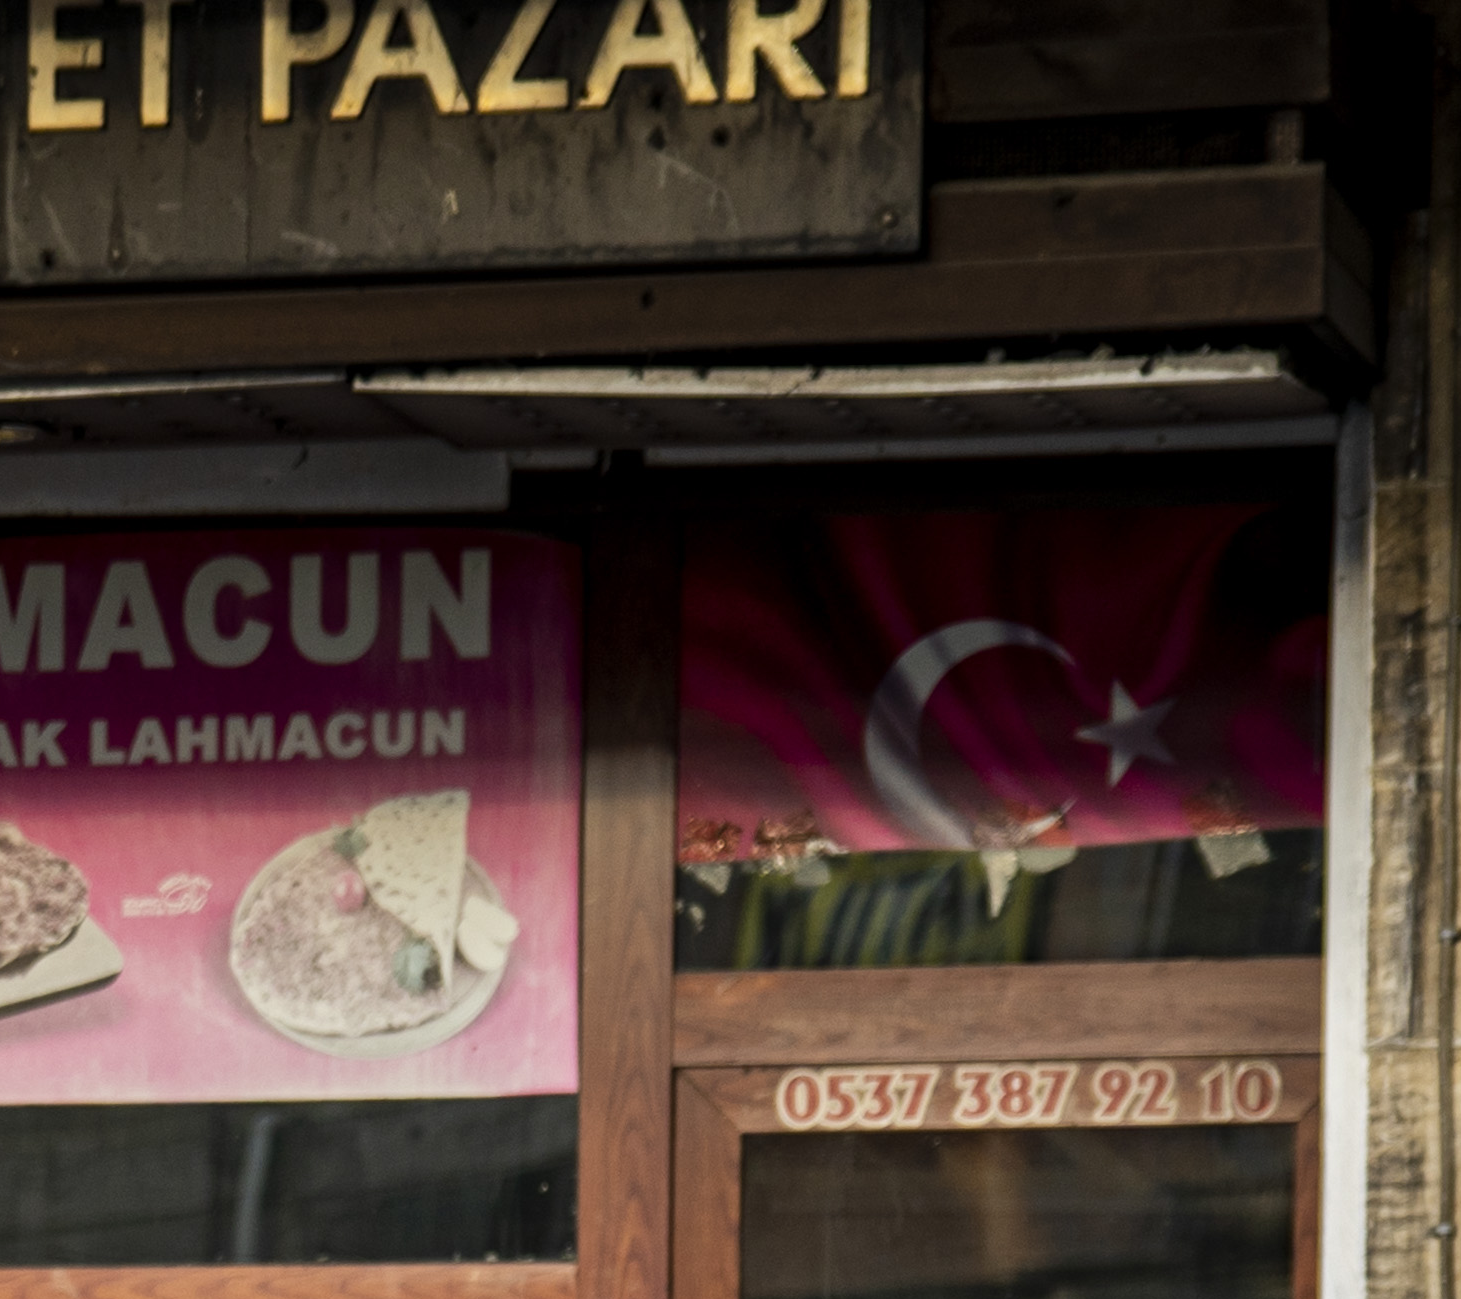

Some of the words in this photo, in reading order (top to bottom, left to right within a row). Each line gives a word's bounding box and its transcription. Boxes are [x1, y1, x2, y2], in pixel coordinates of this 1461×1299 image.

[28, 0, 171, 131] ET
[260, 0, 870, 122] PAZARI
[88, 708, 466, 766] LAHMACUN
[776, 1064, 940, 1131] 0537
[953, 1062, 1080, 1127] 387
[1092, 1061, 1177, 1123] 92
[1201, 1059, 1283, 1121] 10
